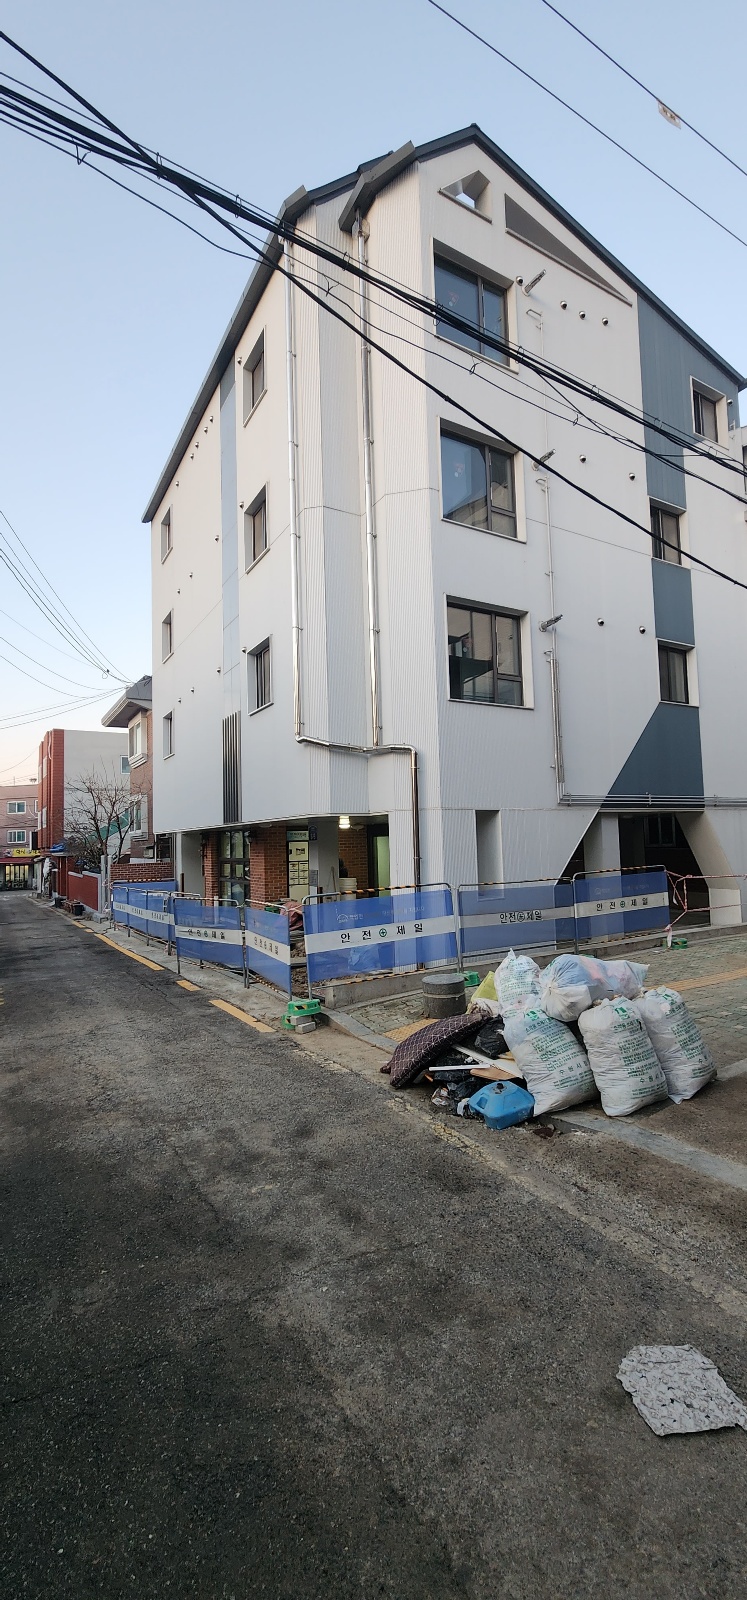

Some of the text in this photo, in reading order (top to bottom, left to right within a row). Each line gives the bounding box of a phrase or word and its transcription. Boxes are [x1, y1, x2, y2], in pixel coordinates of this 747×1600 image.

[596, 897, 648, 912] 안전 제일
[499, 909, 542, 924] 안전 제일
[340, 923, 423, 943] 안전 제일
